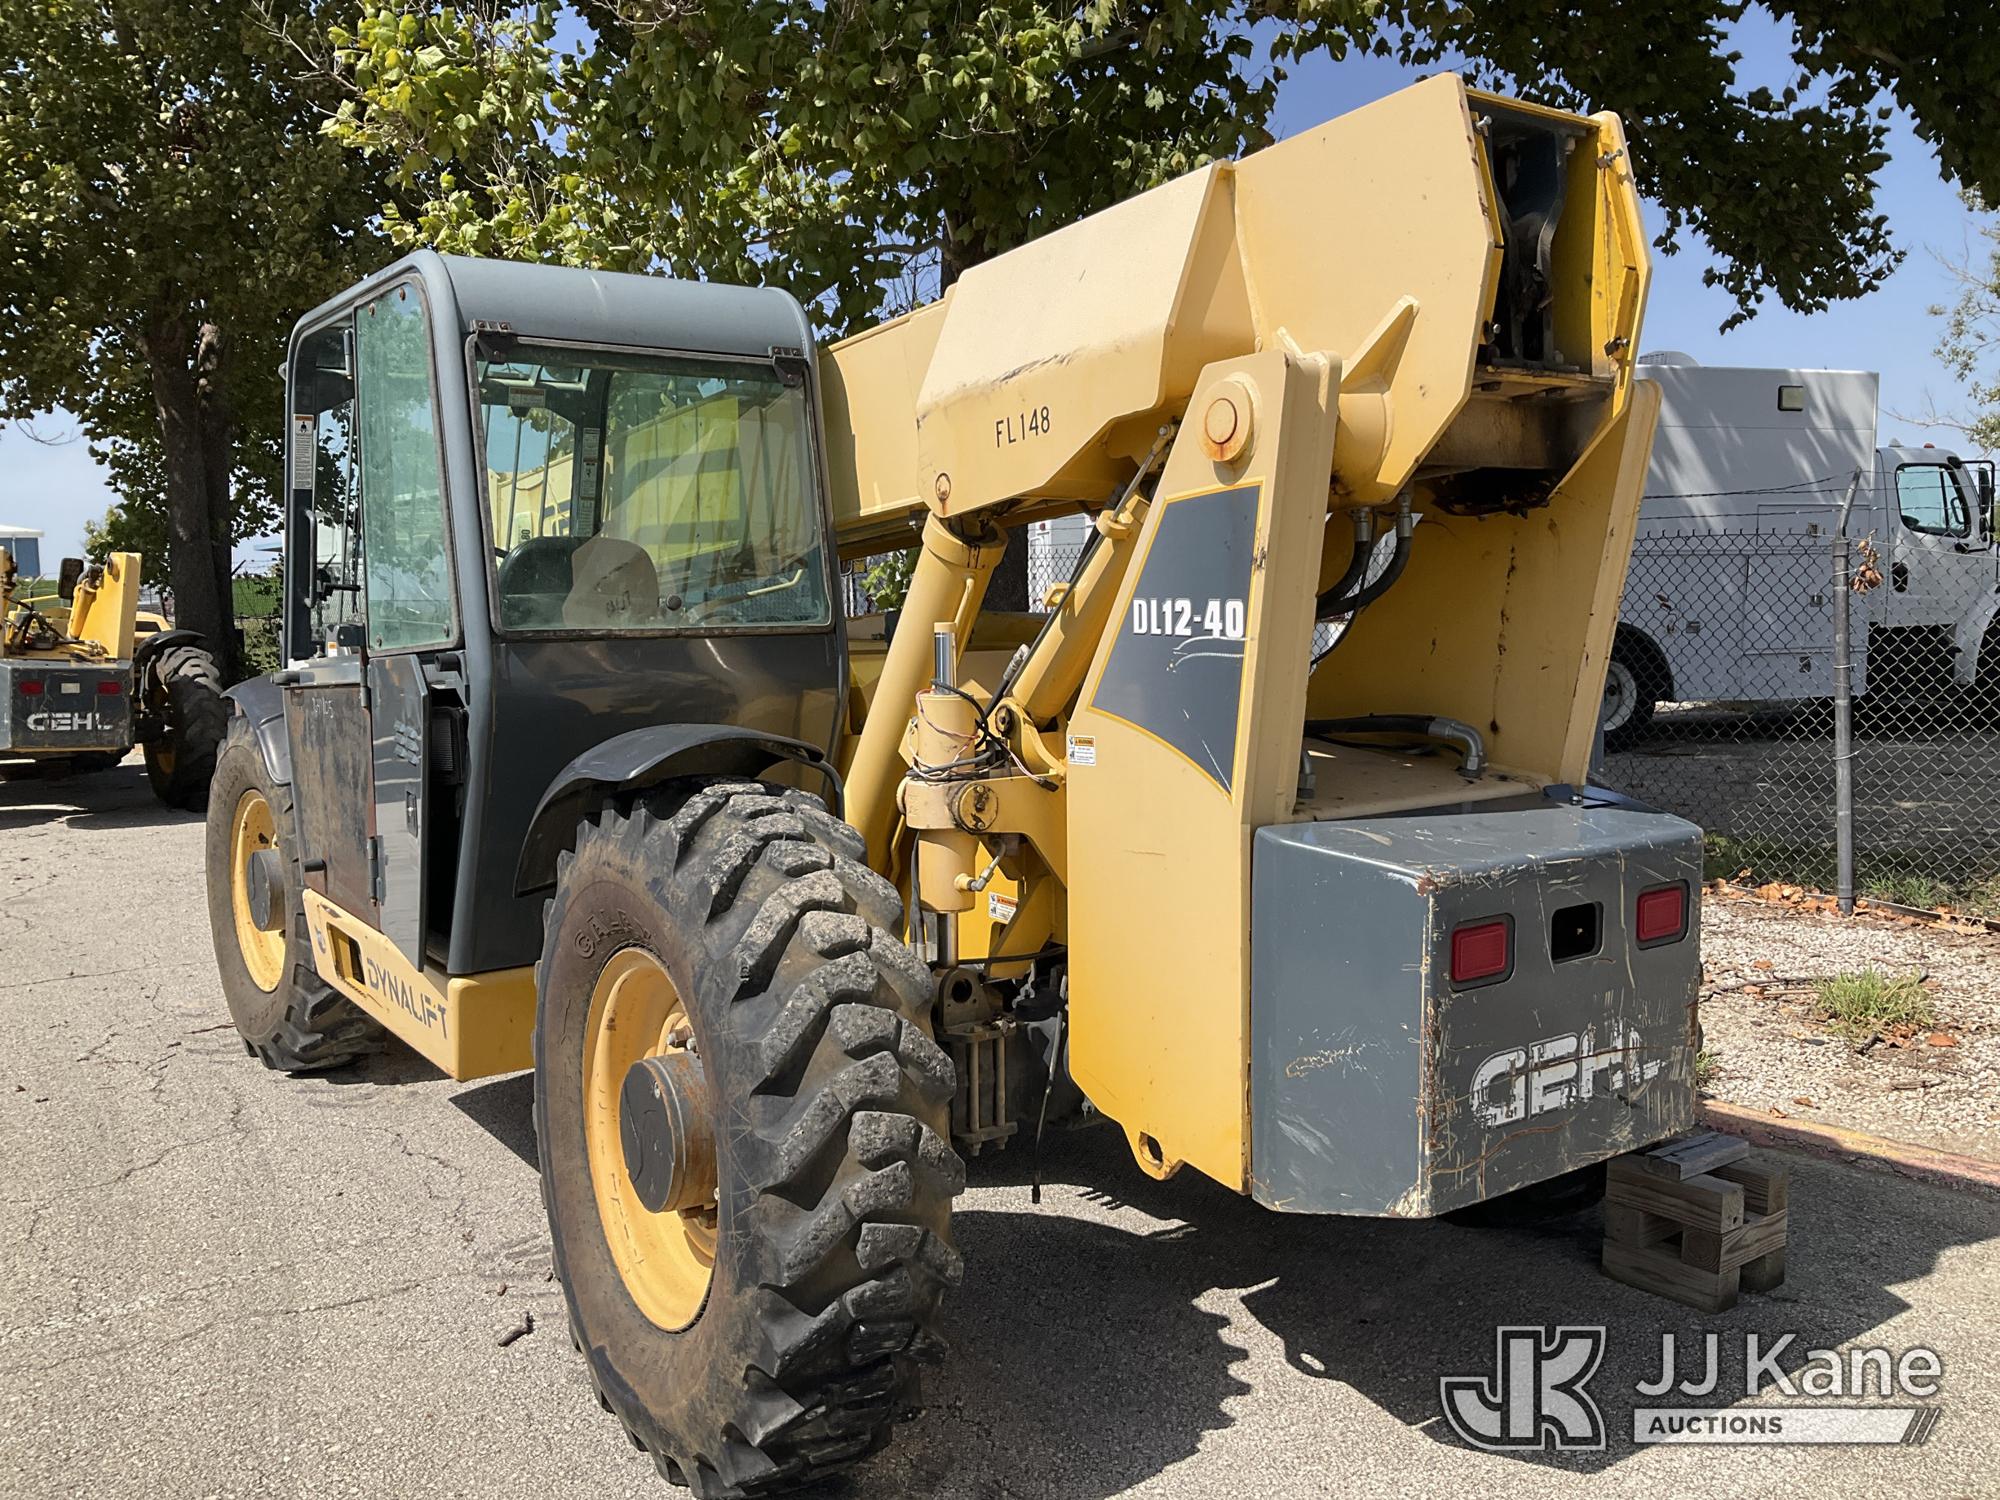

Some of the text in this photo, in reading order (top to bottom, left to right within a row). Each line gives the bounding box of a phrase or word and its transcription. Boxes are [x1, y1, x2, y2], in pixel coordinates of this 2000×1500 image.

[995, 406, 1051, 448] FL148
[1132, 597, 1245, 638] DL12-40
[27, 712, 113, 731] GEHL
[367, 957, 448, 1040] DYNALIFT
[1469, 1022, 1667, 1129] GEHL
